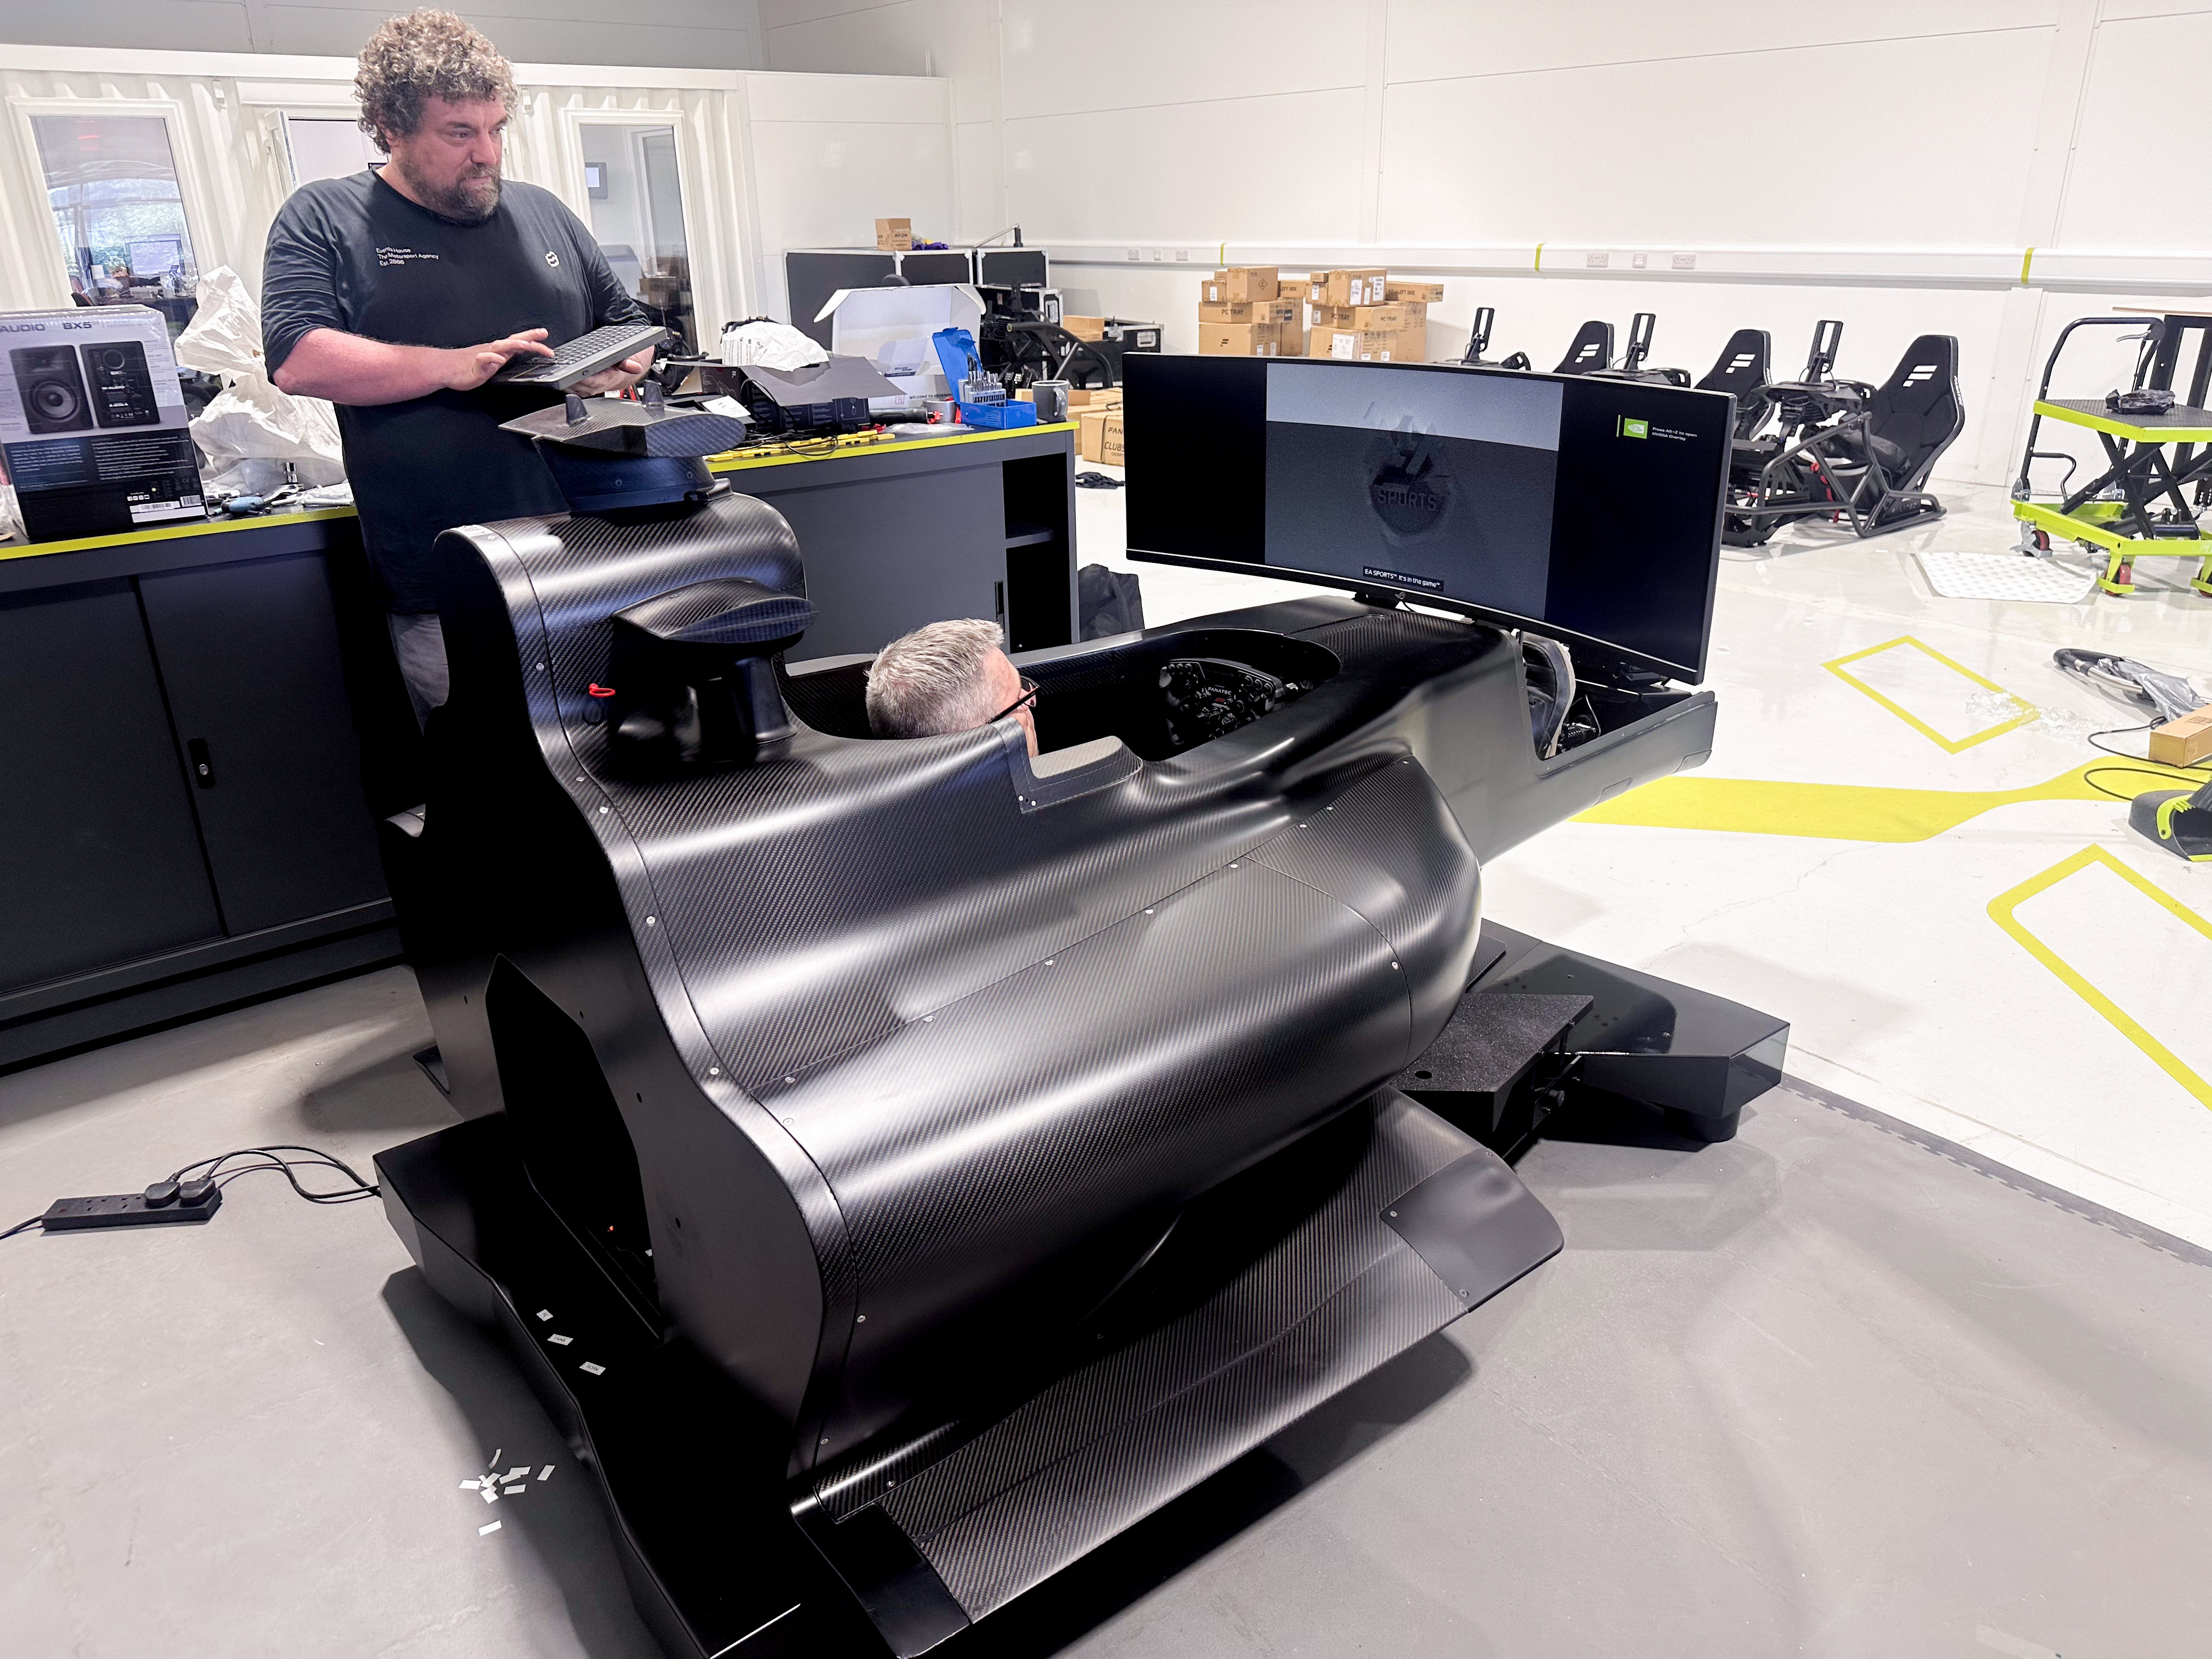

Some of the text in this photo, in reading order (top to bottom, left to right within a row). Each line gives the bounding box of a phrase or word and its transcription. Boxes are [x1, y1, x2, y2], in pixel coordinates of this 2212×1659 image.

[63, 321, 92, 330] BX5
[1377, 489, 1437, 511] SPORTS
[1207, 686, 1232, 695] FANATEC
